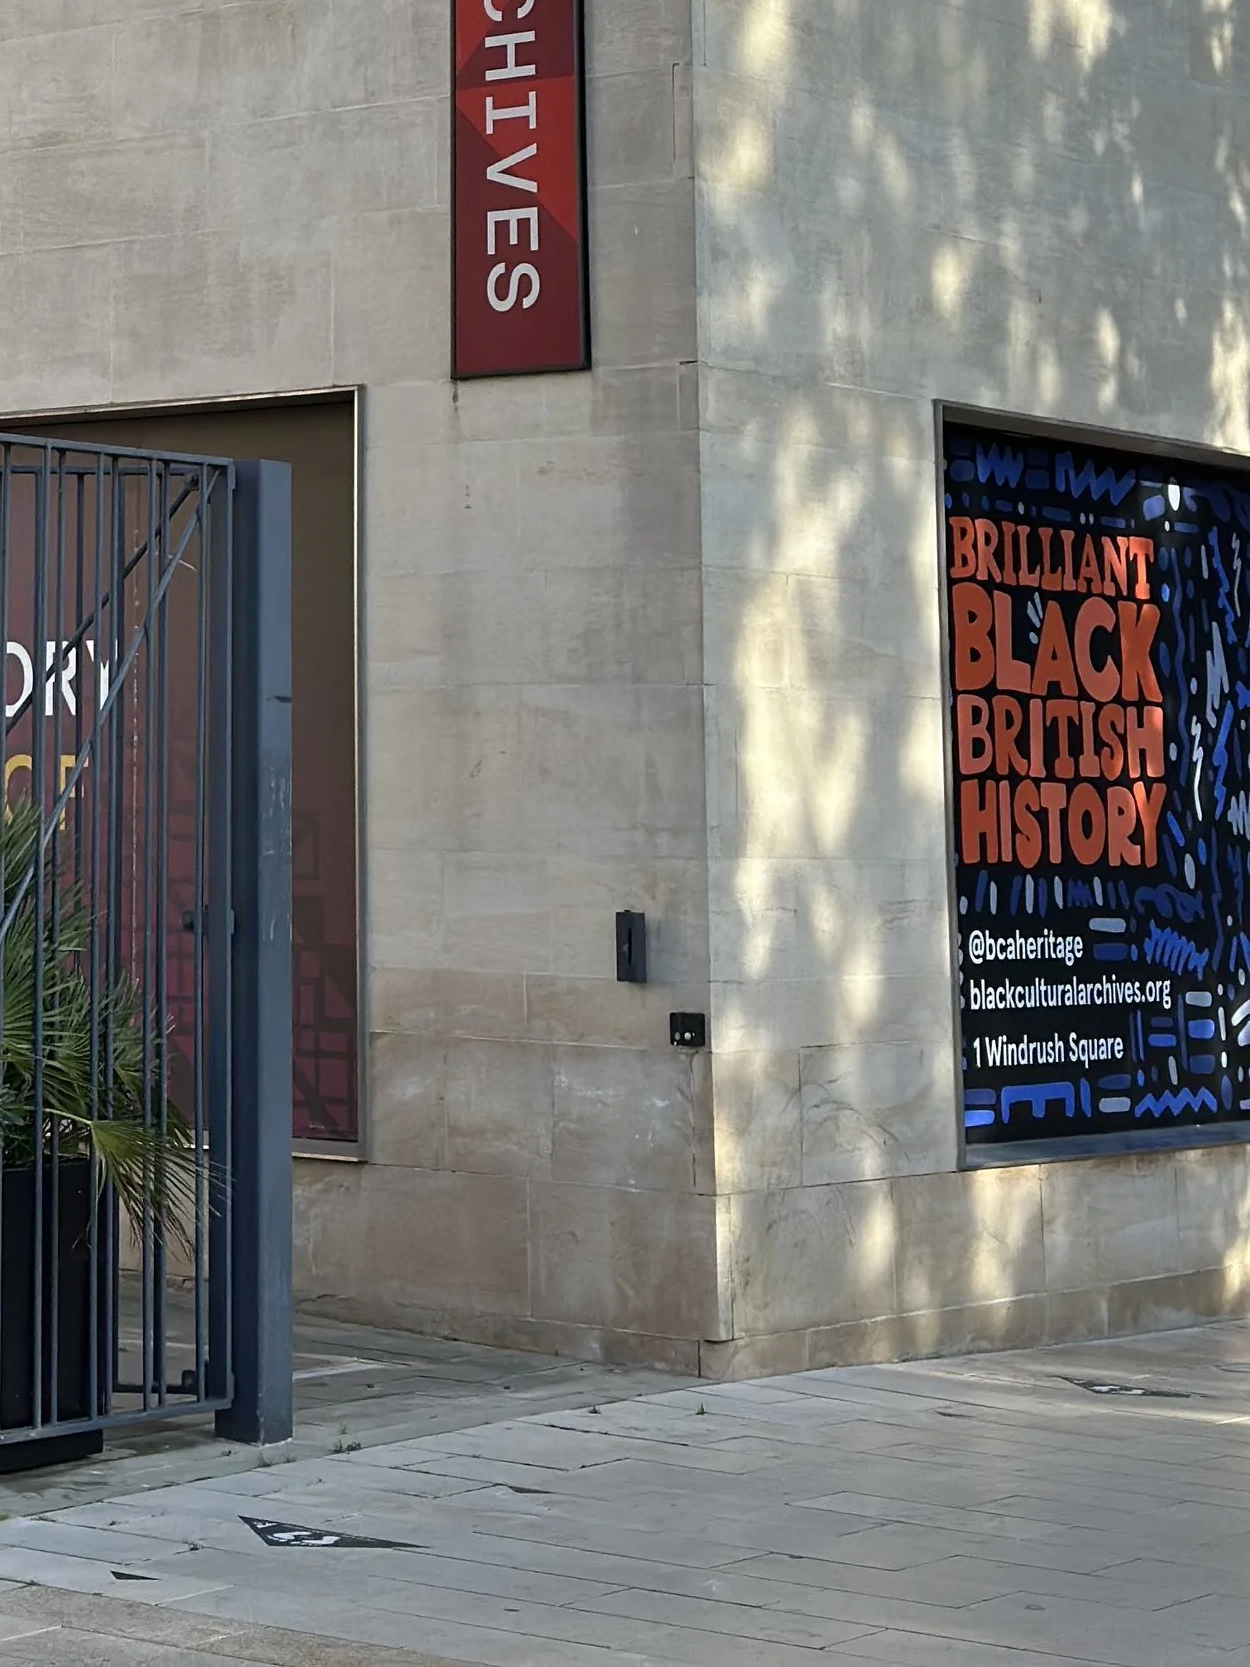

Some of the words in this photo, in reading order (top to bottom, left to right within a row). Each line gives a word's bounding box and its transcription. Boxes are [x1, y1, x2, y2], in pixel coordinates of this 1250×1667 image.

[949, 516, 1154, 600] BRILLIANT
[952, 582, 1163, 703] BLACK
[957, 694, 1166, 781] BRITISH
[960, 779, 1167, 869] HISTORY
[968, 928, 1084, 967] @bcaheritage
[969, 974, 1172, 1010] blackculturalarchives.org
[973, 1037, 982, 1069] 1
[985, 1032, 1065, 1068] Windrush
[1069, 1032, 1125, 1069] Square
